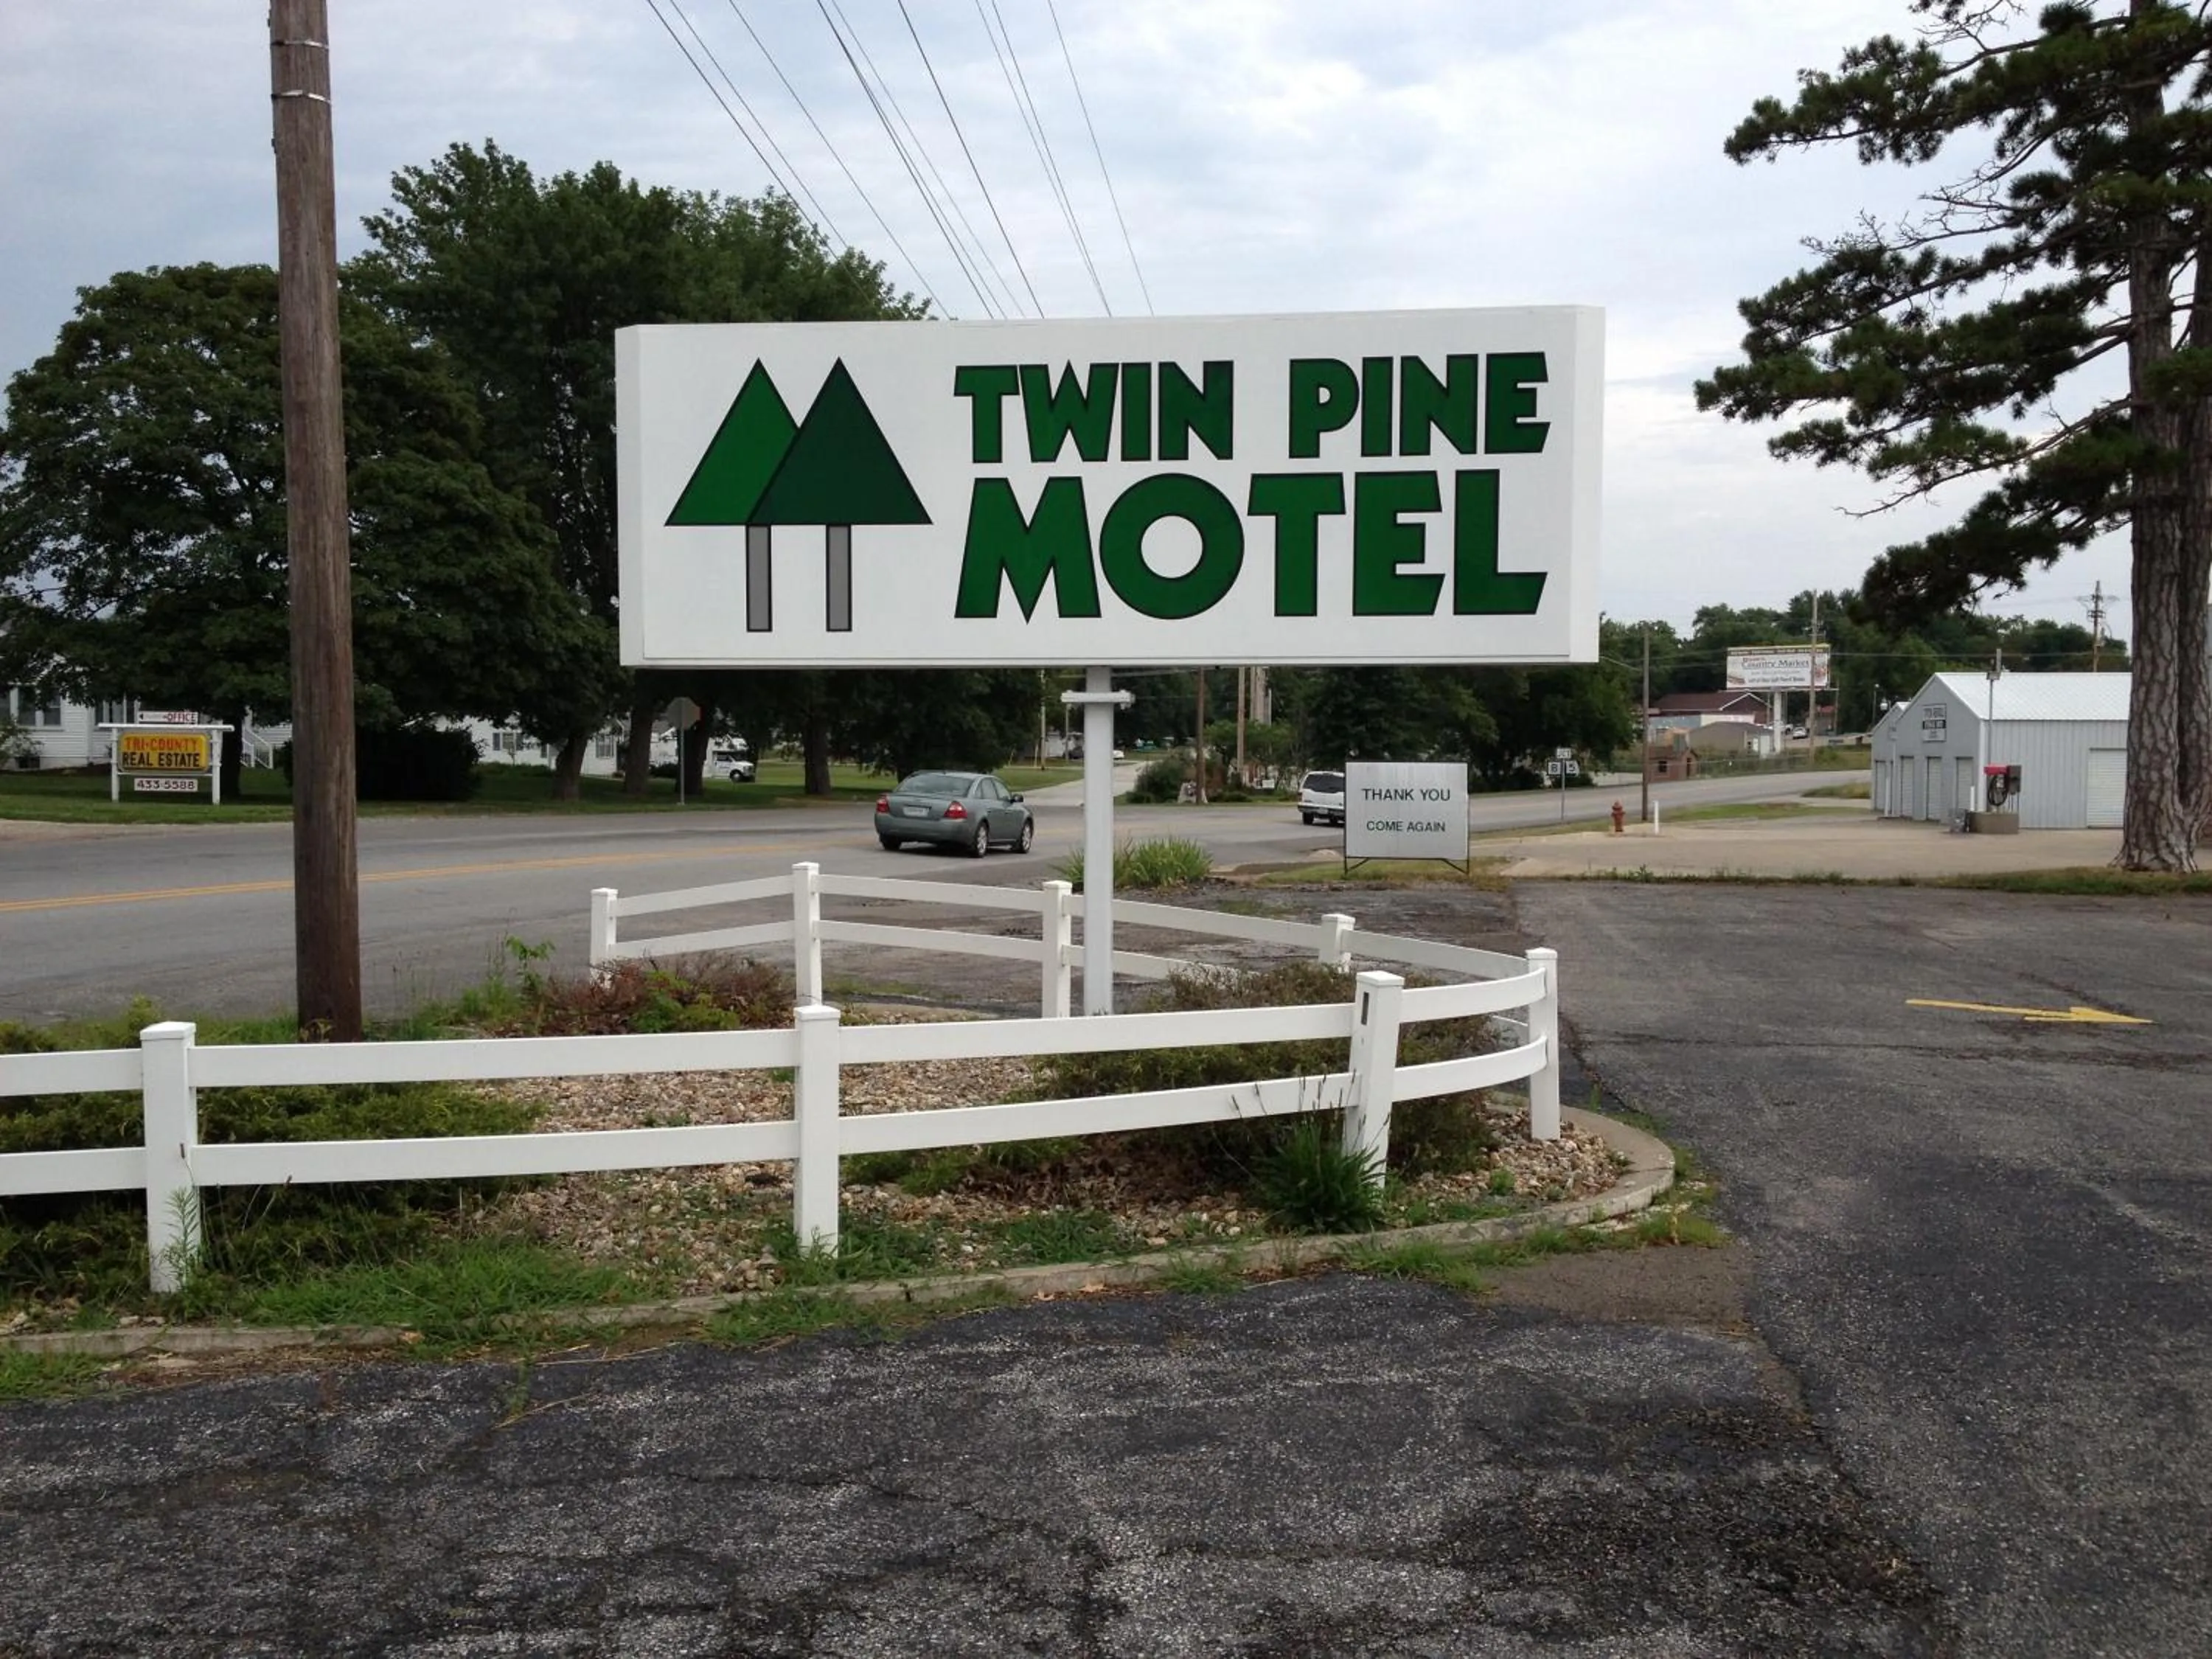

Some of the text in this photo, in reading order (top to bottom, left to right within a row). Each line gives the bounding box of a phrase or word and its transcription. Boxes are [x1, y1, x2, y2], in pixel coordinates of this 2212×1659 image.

[953, 352, 1551, 464] TWIN PINE
[954, 468, 1548, 624] MOTEL
[122, 751, 200, 768] REAL ESTATE
[1361, 788, 1450, 801] THANK YOU
[1366, 821, 1446, 832] COME AGAIN
